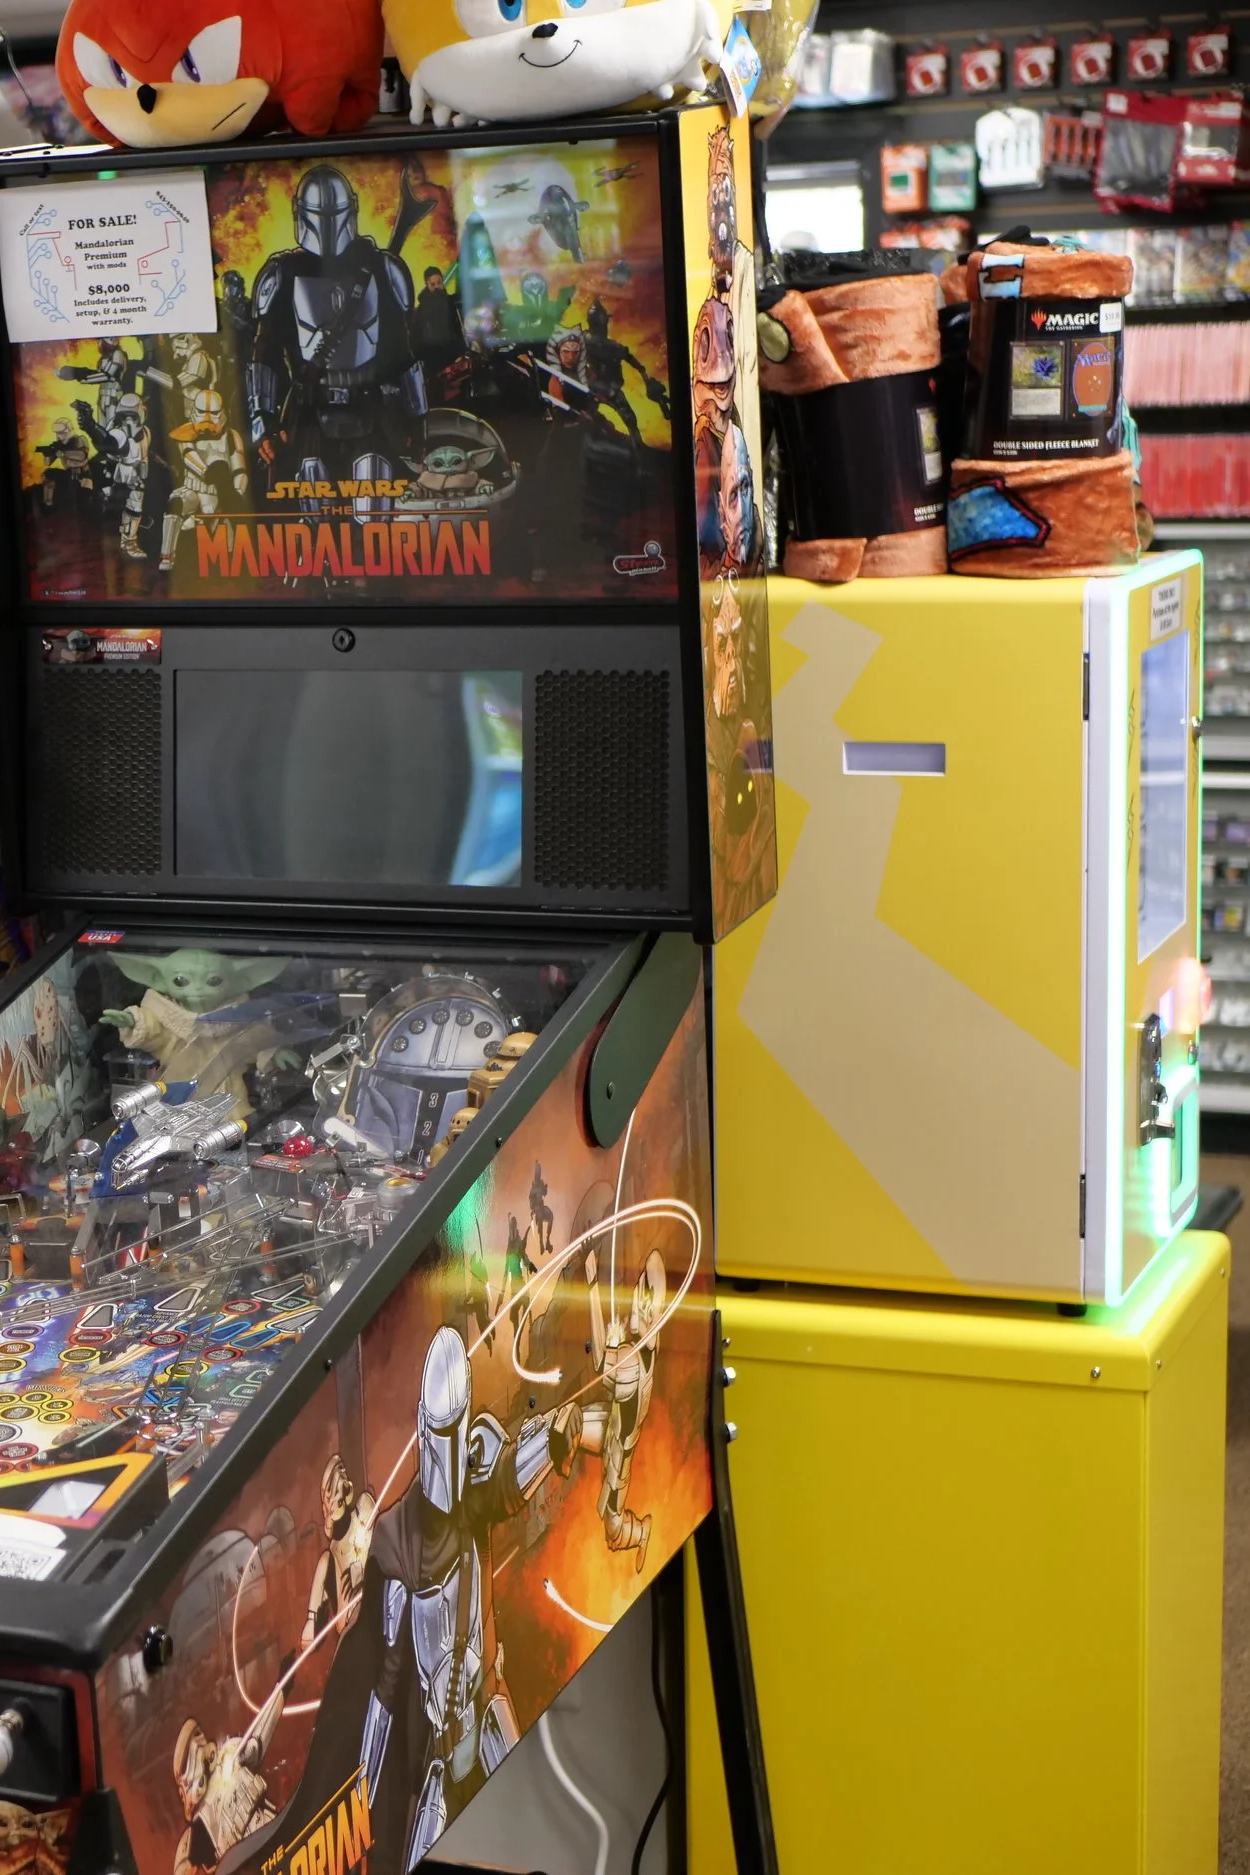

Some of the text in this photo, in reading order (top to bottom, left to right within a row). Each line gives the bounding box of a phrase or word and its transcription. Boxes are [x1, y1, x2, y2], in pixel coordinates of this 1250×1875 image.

[68, 214, 138, 230] FOR SALE!
[74, 238, 135, 250] Mandalorian
[84, 252, 128, 261] Premium
[107, 261, 127, 269] mods
[88, 283, 130, 296] $8,000
[74, 295, 147, 307] Includes delivery,
[76, 308, 101, 318] setup,
[120, 305, 147, 314] month
[91, 318, 133, 327] warranty.
[1045, 312, 1099, 326] MAGIC
[993, 438, 1100, 450] DOUBLE SIDED FLEECE BLANKET
[266, 479, 410, 499] STAR WARS
[321, 505, 353, 515] THE
[196, 519, 492, 577] MANDALORIAN
[96, 641, 148, 653] MANDALORIAN
[87, 933, 112, 941] USA
[429, 1092, 439, 1108] 3
[422, 1121, 433, 1137] 2
[260, 1844, 285, 1875] THE
